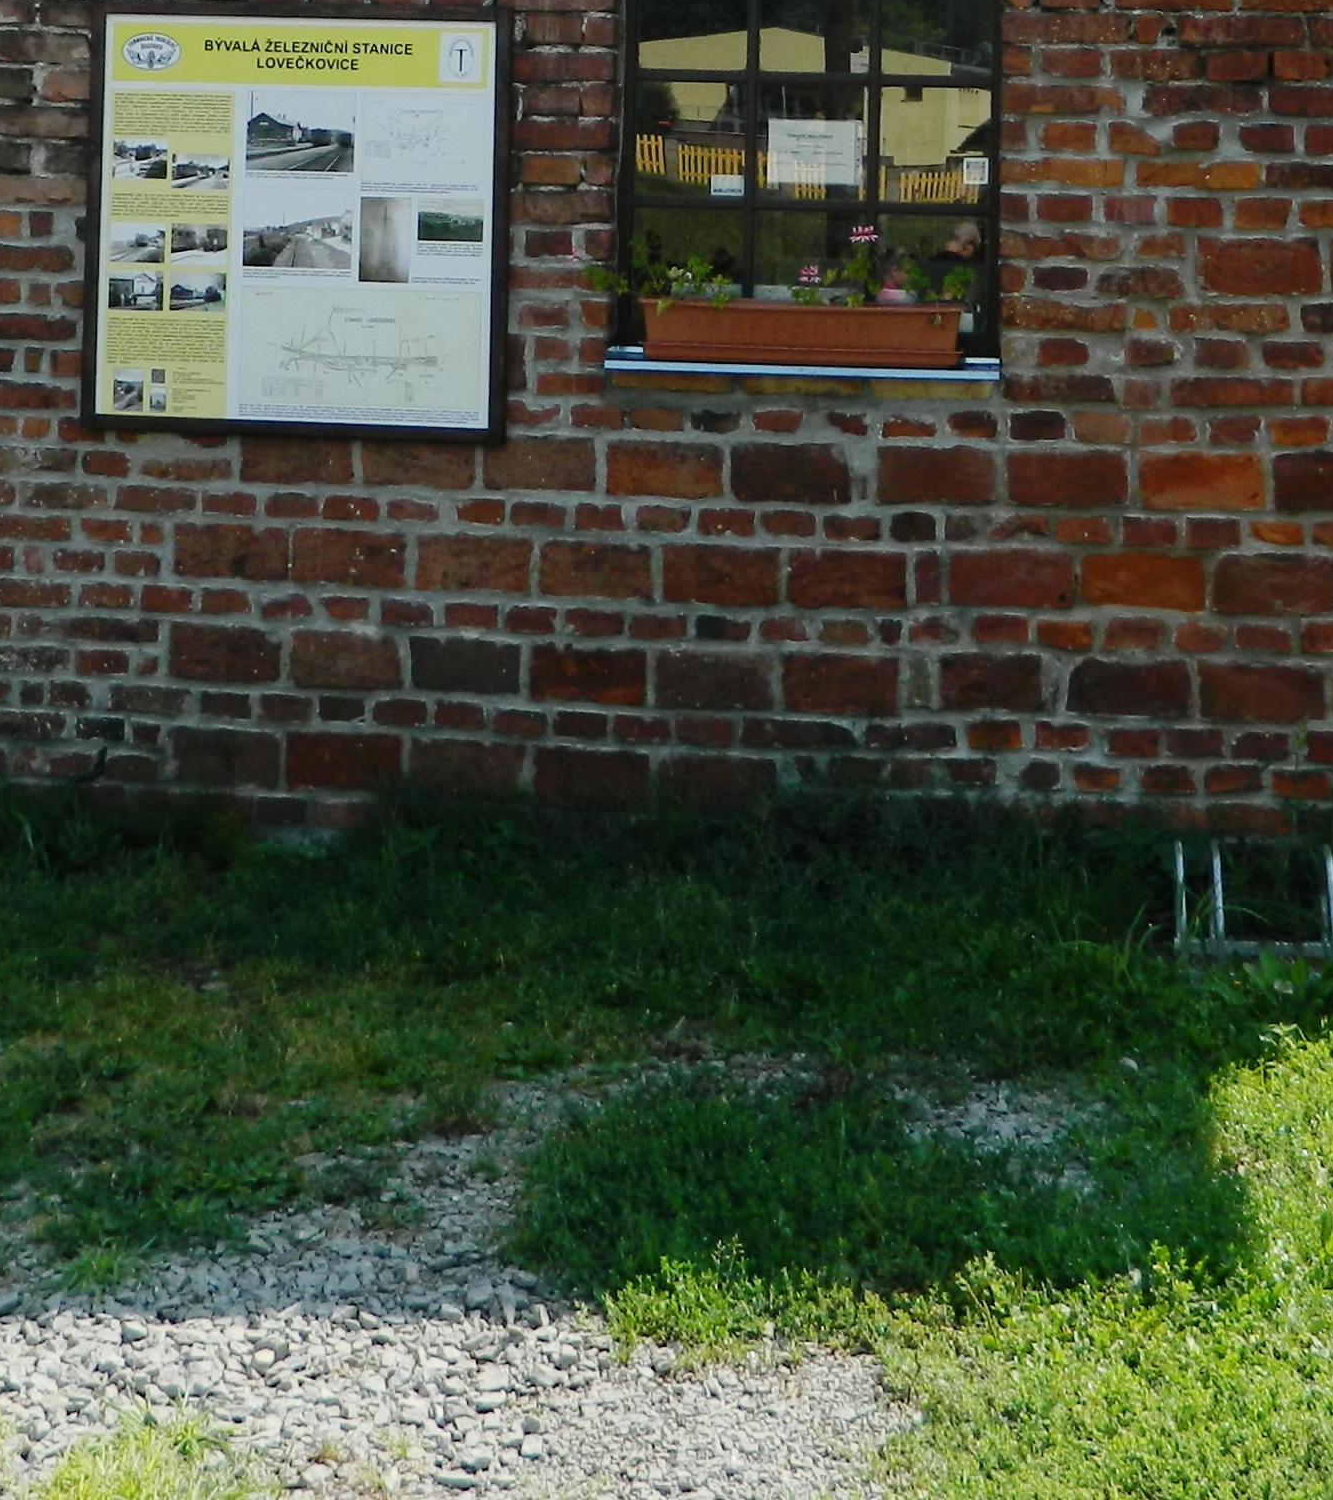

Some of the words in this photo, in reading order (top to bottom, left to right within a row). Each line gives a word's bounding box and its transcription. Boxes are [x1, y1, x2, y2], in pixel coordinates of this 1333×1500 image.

[204, 37, 260, 52] BÝVALÁ
[264, 38, 348, 54] ŽELEZNIČNÍ
[352, 42, 413, 56] STANICE
[256, 55, 359, 71] LOVEČKOVICE
